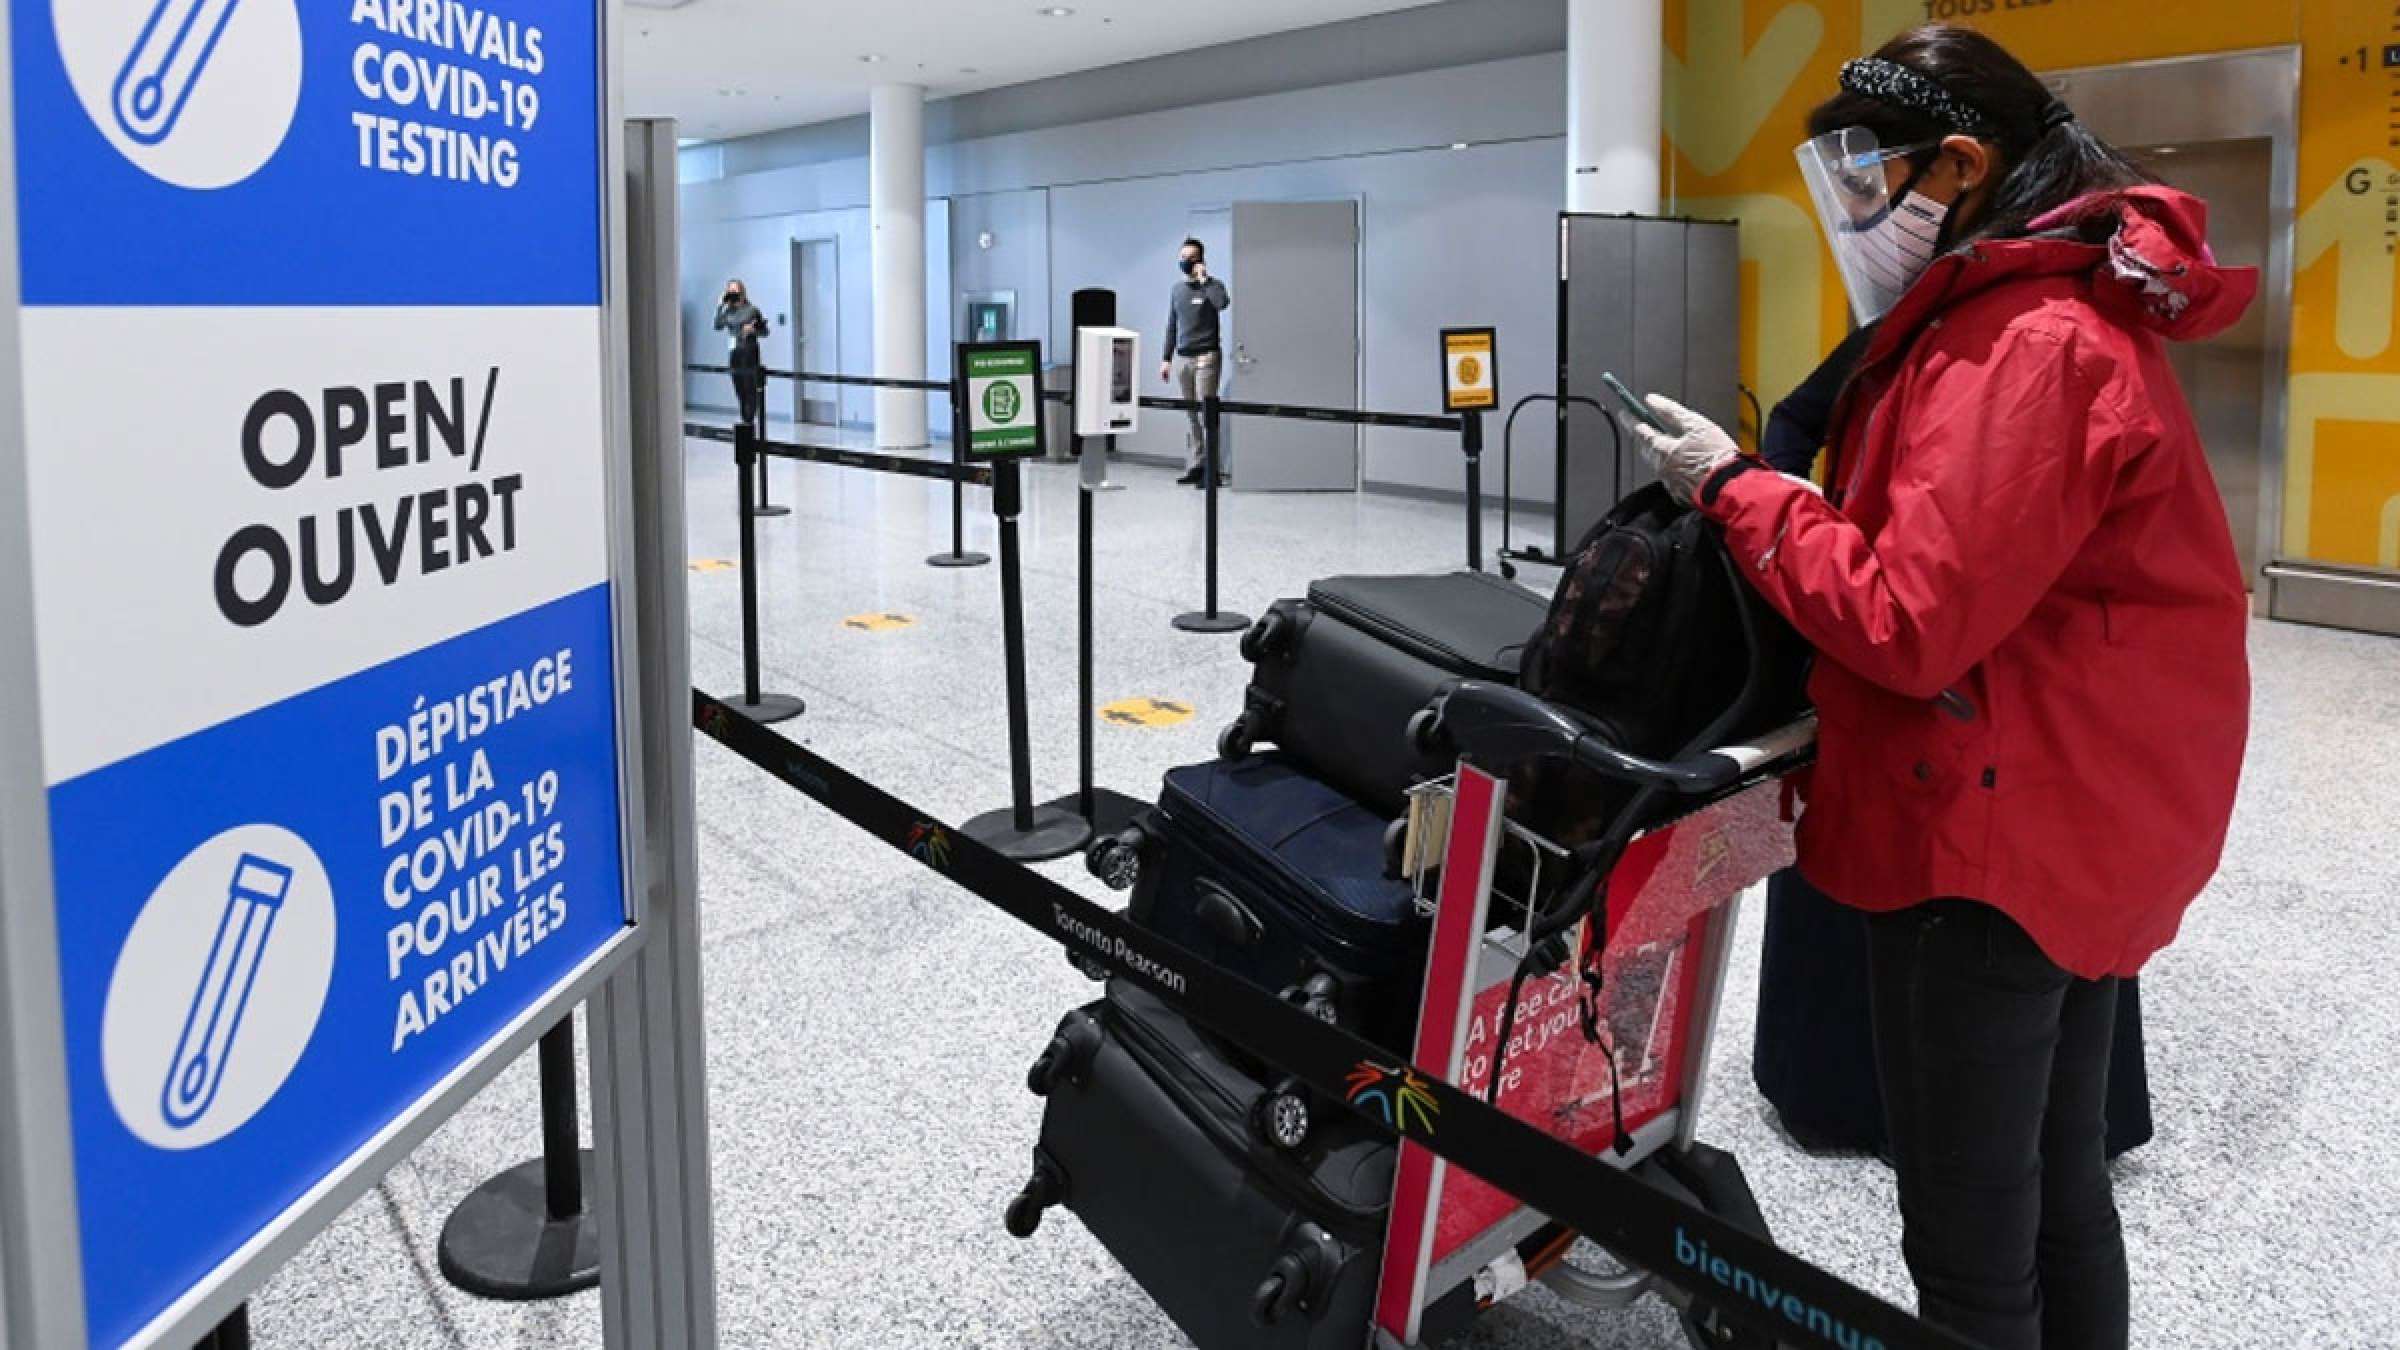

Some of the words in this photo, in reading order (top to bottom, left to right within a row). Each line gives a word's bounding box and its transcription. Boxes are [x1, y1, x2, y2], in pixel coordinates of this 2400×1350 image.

[352, 42, 539, 131] COVID-19
[351, 111, 520, 188] TESTING
[2345, 167, 2371, 195] G
[241, 366, 500, 489] OPEN/
[213, 473, 523, 627] OUVERT
[376, 649, 572, 781] DÉPISTAGE
[380, 775, 433, 848] DE
[446, 748, 495, 812] LA
[383, 769, 560, 909] COVID-19
[387, 864, 503, 980] POUR
[513, 822, 566, 893] LES
[1053, 902, 1113, 955] Toronto
[1115, 936, 1186, 993] Pearson
[391, 881, 568, 1053] ARRIVÉES
[1462, 1055, 1488, 1085] to
[1465, 1015, 1485, 1050] A
[1495, 993, 1543, 1036] fee
